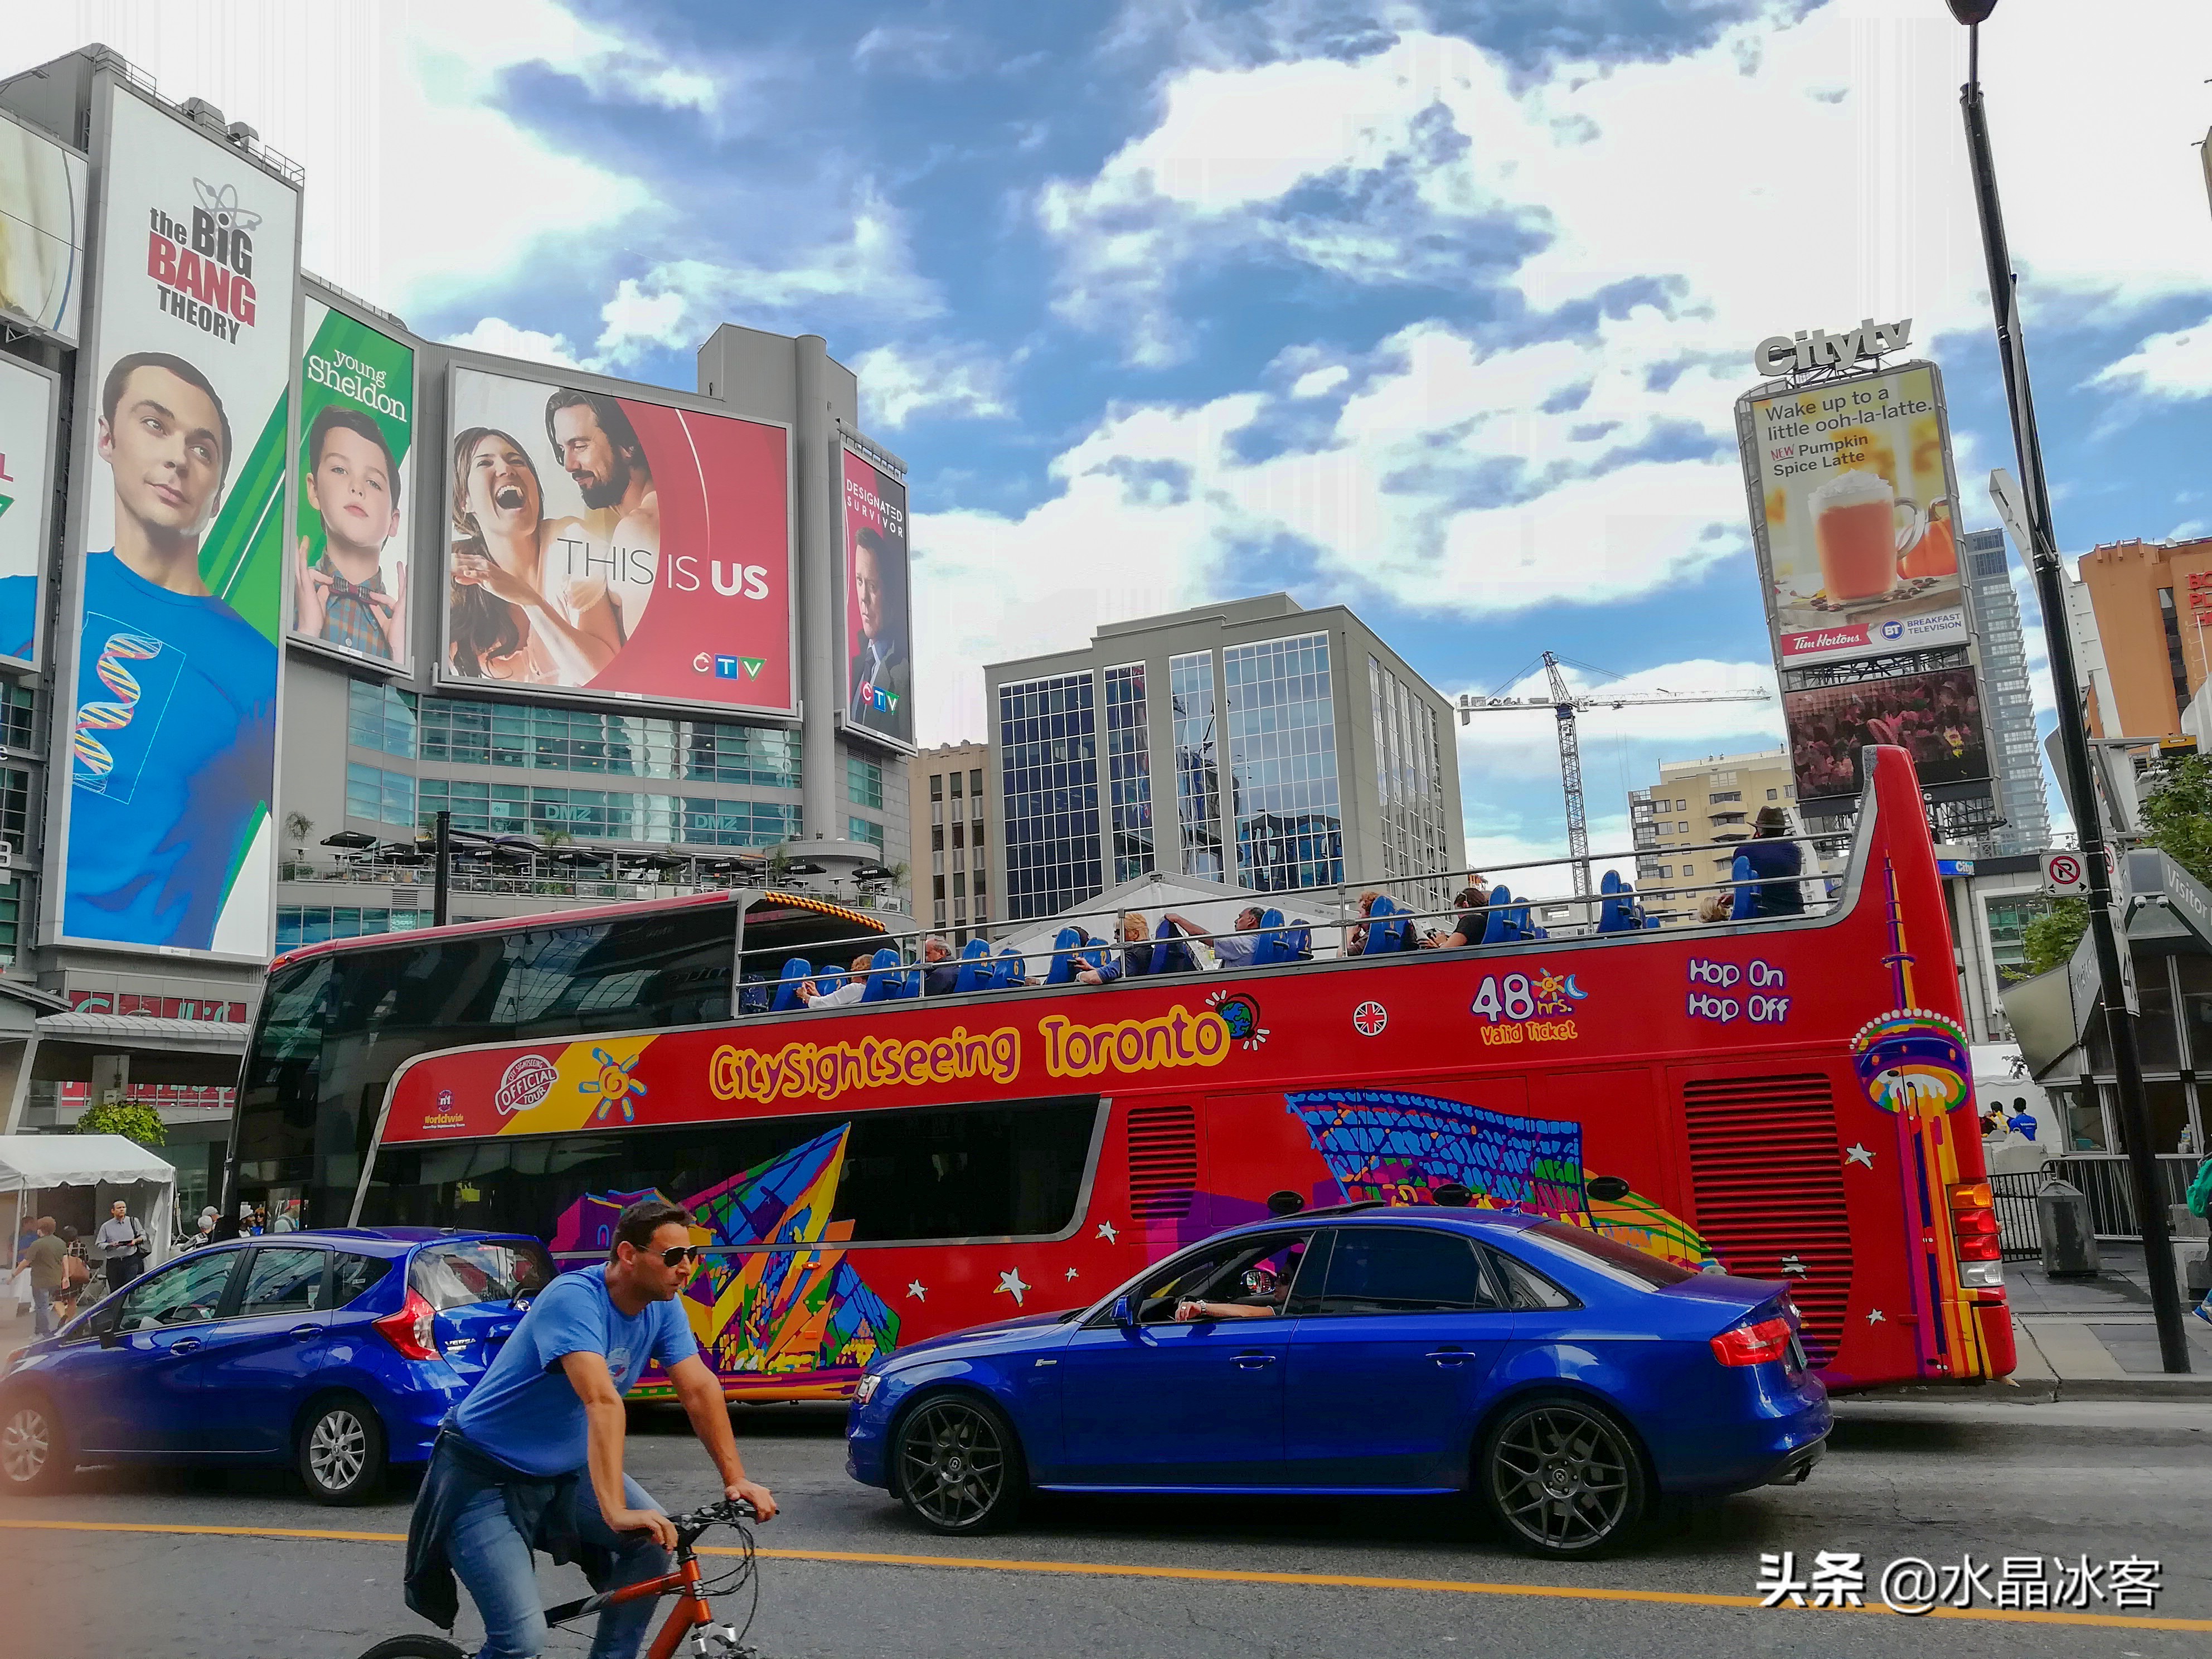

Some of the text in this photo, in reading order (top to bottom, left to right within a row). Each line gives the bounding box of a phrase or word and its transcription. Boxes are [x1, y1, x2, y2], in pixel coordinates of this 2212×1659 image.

[149, 207, 187, 246] the
[147, 230, 256, 328] BANG
[157, 284, 241, 346] THEORY
[1754, 318, 1913, 376] Citytv
[333, 348, 387, 389] young
[307, 355, 407, 422] Sheldon
[1765, 388, 1889, 421] Wake up to a
[1767, 400, 1932, 441] little ooh-la-latte.
[1770, 434, 1869, 462] NEW Pumpkin
[1773, 452, 1865, 478] Spice Latte
[846, 478, 903, 523] DESIGNATED
[846, 496, 903, 539] SURVIVOR
[556, 537, 769, 600] THIS IS US
[1882, 624, 1901, 636] BT
[1907, 613, 1961, 628] BREAKFAST
[1908, 620, 1962, 635] TELEVISION
[1793, 636, 1815, 651] Tim
[692, 652, 767, 681] CTV
[860, 681, 899, 716] CTV
[545, 804, 591, 822] DMZ
[694, 813, 738, 831] DMZ
[2167, 863, 2208, 919] Visitor
[1689, 959, 1784, 988] Hop On
[1471, 973, 1535, 1023] 48
[1688, 993, 1789, 1022] Hop Off
[1039, 1004, 1231, 1078] Toronto
[1480, 1020, 1578, 1046] Valid Ticket
[501, 1069, 556, 1106] OFFICIAL
[508, 1069, 517, 1081] CITY
[523, 1086, 546, 1104] TOUR
